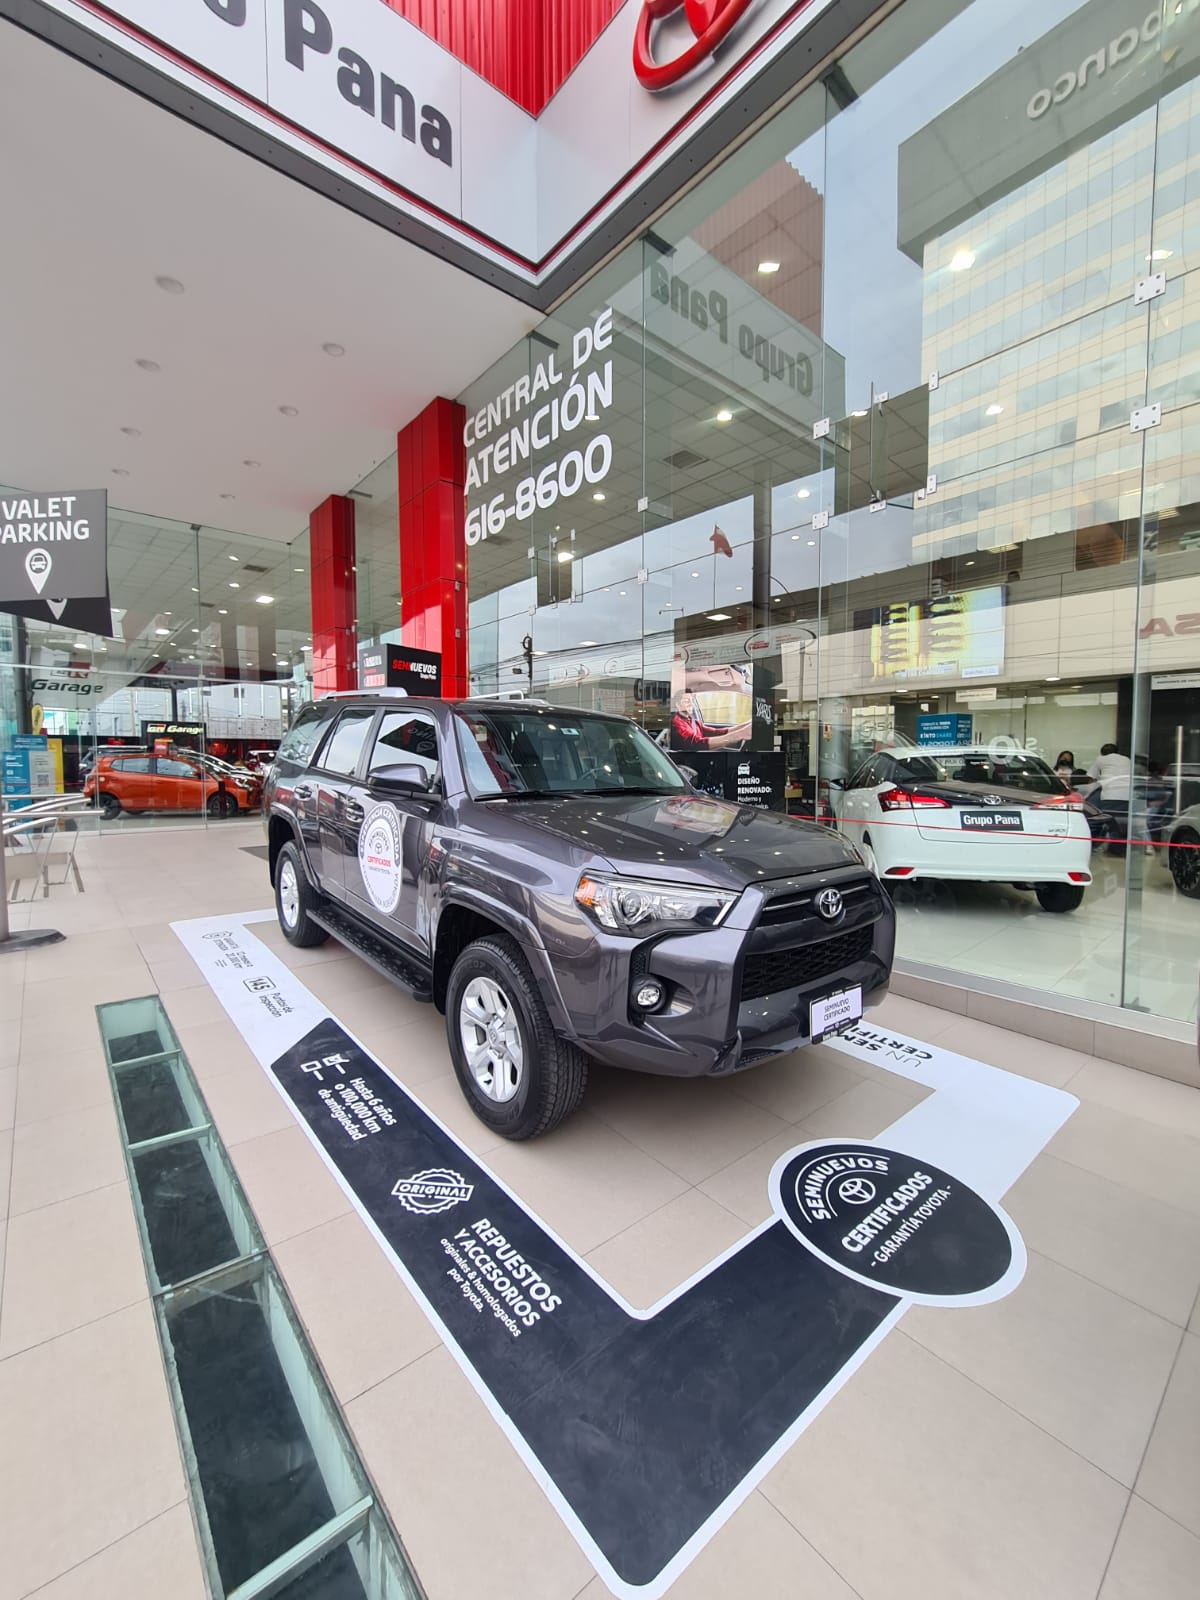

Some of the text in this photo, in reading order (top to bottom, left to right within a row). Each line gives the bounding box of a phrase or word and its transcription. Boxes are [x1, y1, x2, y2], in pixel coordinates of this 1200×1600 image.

[283, 0, 452, 168] Pana
[462, 306, 613, 448] CENTRAL DE
[463, 359, 613, 497] ATENCIÓN
[1, 496, 77, 520] VALET
[464, 434, 613, 546] 616-8600
[0, 519, 90, 544] ARKING
[31, 678, 103, 696] Garage
[737, 776, 760, 785] DISEÑO
[963, 814, 1020, 826] Grupo Pana
[259, 995, 283, 1018] inspección
[269, 992, 288, 1007] Puntos
[823, 1005, 851, 1021] CERTIFICADO
[824, 997, 849, 1014] SEMINUEVO
[885, 1050, 922, 1068] UN
[318, 1089, 368, 1141] de antigüedad
[339, 1088, 372, 1118] 100,000
[362, 1115, 381, 1133] km
[349, 1077, 397, 1126] Hasta 6 años
[399, 1183, 468, 1198] ORIGINAL
[804, 1157, 889, 1220] SEMINUEVOS
[841, 1171, 933, 1253] CERTIFICADOS
[874, 1219, 923, 1263] GARANTÍA
[914, 1188, 952, 1220] TOYOTA
[440, 1238, 522, 1337] originales & homologados
[454, 1228, 541, 1327] Y ACCESORIOS
[471, 1218, 563, 1312] REPUESTOS
[447, 1268, 484, 1313] por Toyota.
